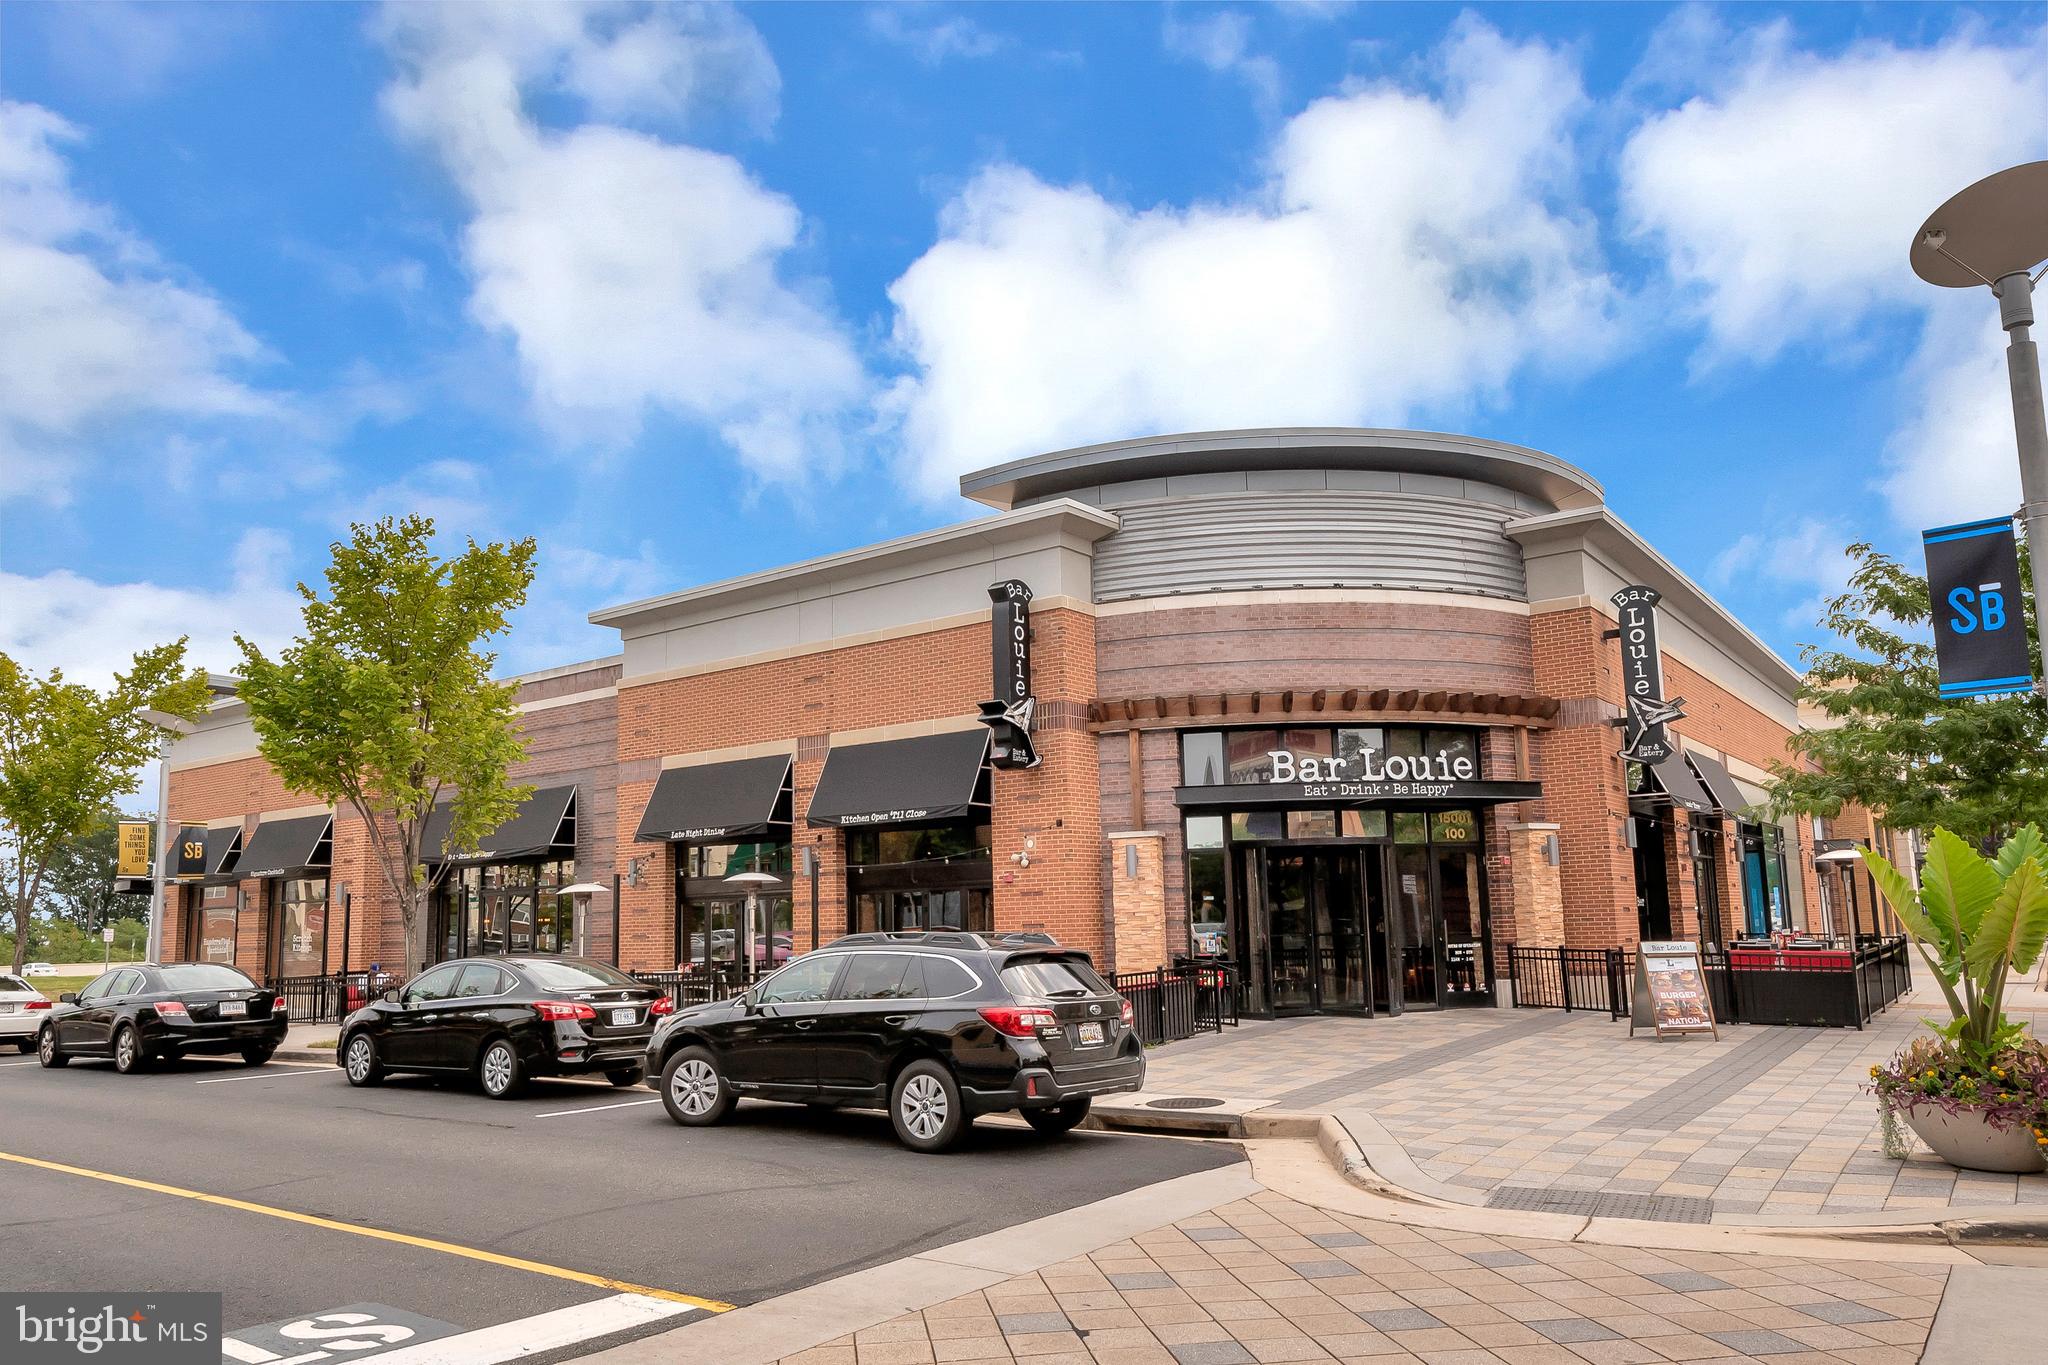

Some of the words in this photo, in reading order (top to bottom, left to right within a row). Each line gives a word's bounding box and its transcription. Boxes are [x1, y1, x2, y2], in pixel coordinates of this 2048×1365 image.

[1005, 582, 1032, 601] Bar
[1613, 590, 1655, 607] Bar
[1013, 602, 1026, 696] Louie
[1627, 607, 1650, 695] Louie
[1267, 750, 1347, 783] Bar
[1359, 748, 1474, 781] Louie
[1304, 785, 1328, 796] Eat
[1340, 784, 1381, 795] Drink
[1392, 783, 1409, 794] Be
[840, 815, 870, 824] Kitchen
[870, 813, 889, 822] Open
[905, 809, 927, 818] Close
[670, 831, 686, 839] Late
[685, 829, 703, 838] Night
[703, 827, 726, 836] Dining
[1444, 828, 1465, 840] 100
[124, 841, 146, 849] THINGS
[1660, 991, 1697, 999] BURGER
[1668, 1016, 1701, 1025] NATION
